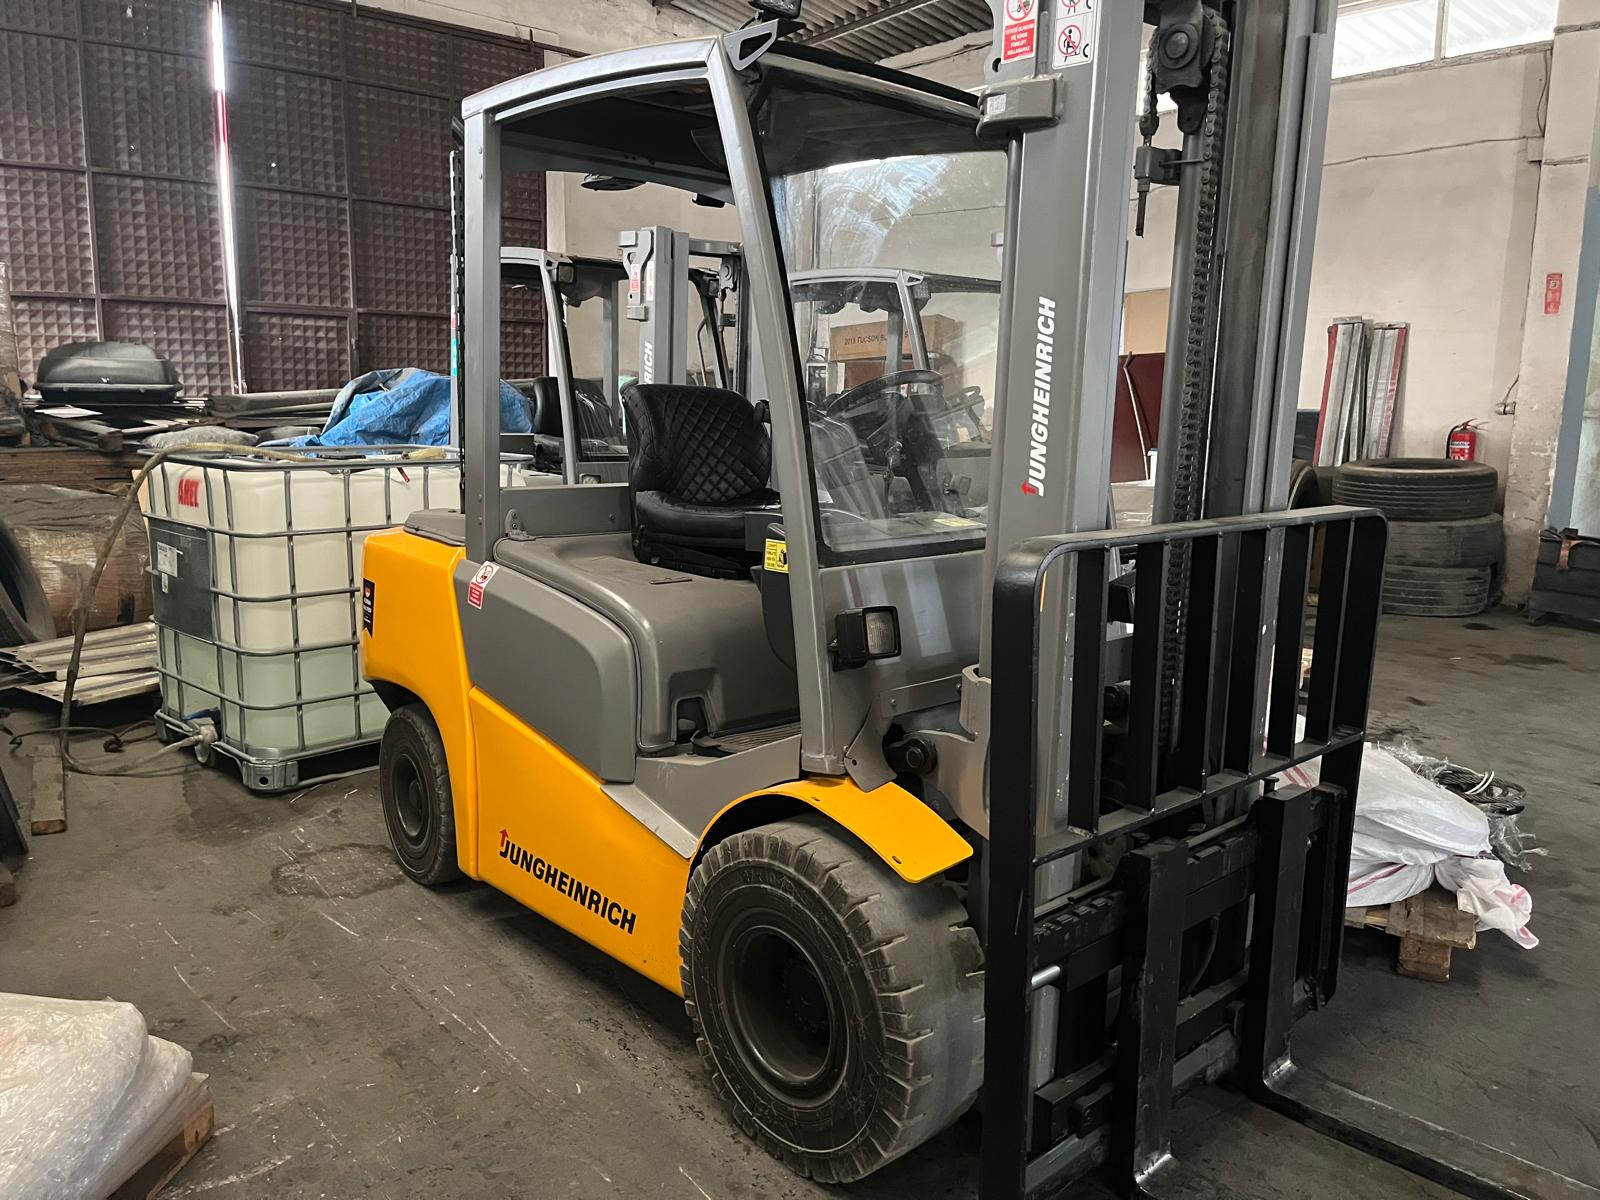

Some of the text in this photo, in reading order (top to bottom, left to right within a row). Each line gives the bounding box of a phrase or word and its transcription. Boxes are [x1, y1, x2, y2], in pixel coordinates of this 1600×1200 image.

[643, 341, 654, 384] RICH
[1027, 296, 1056, 497] JUNGHEINRICH
[499, 839, 637, 935] JUNGHEINRICH
